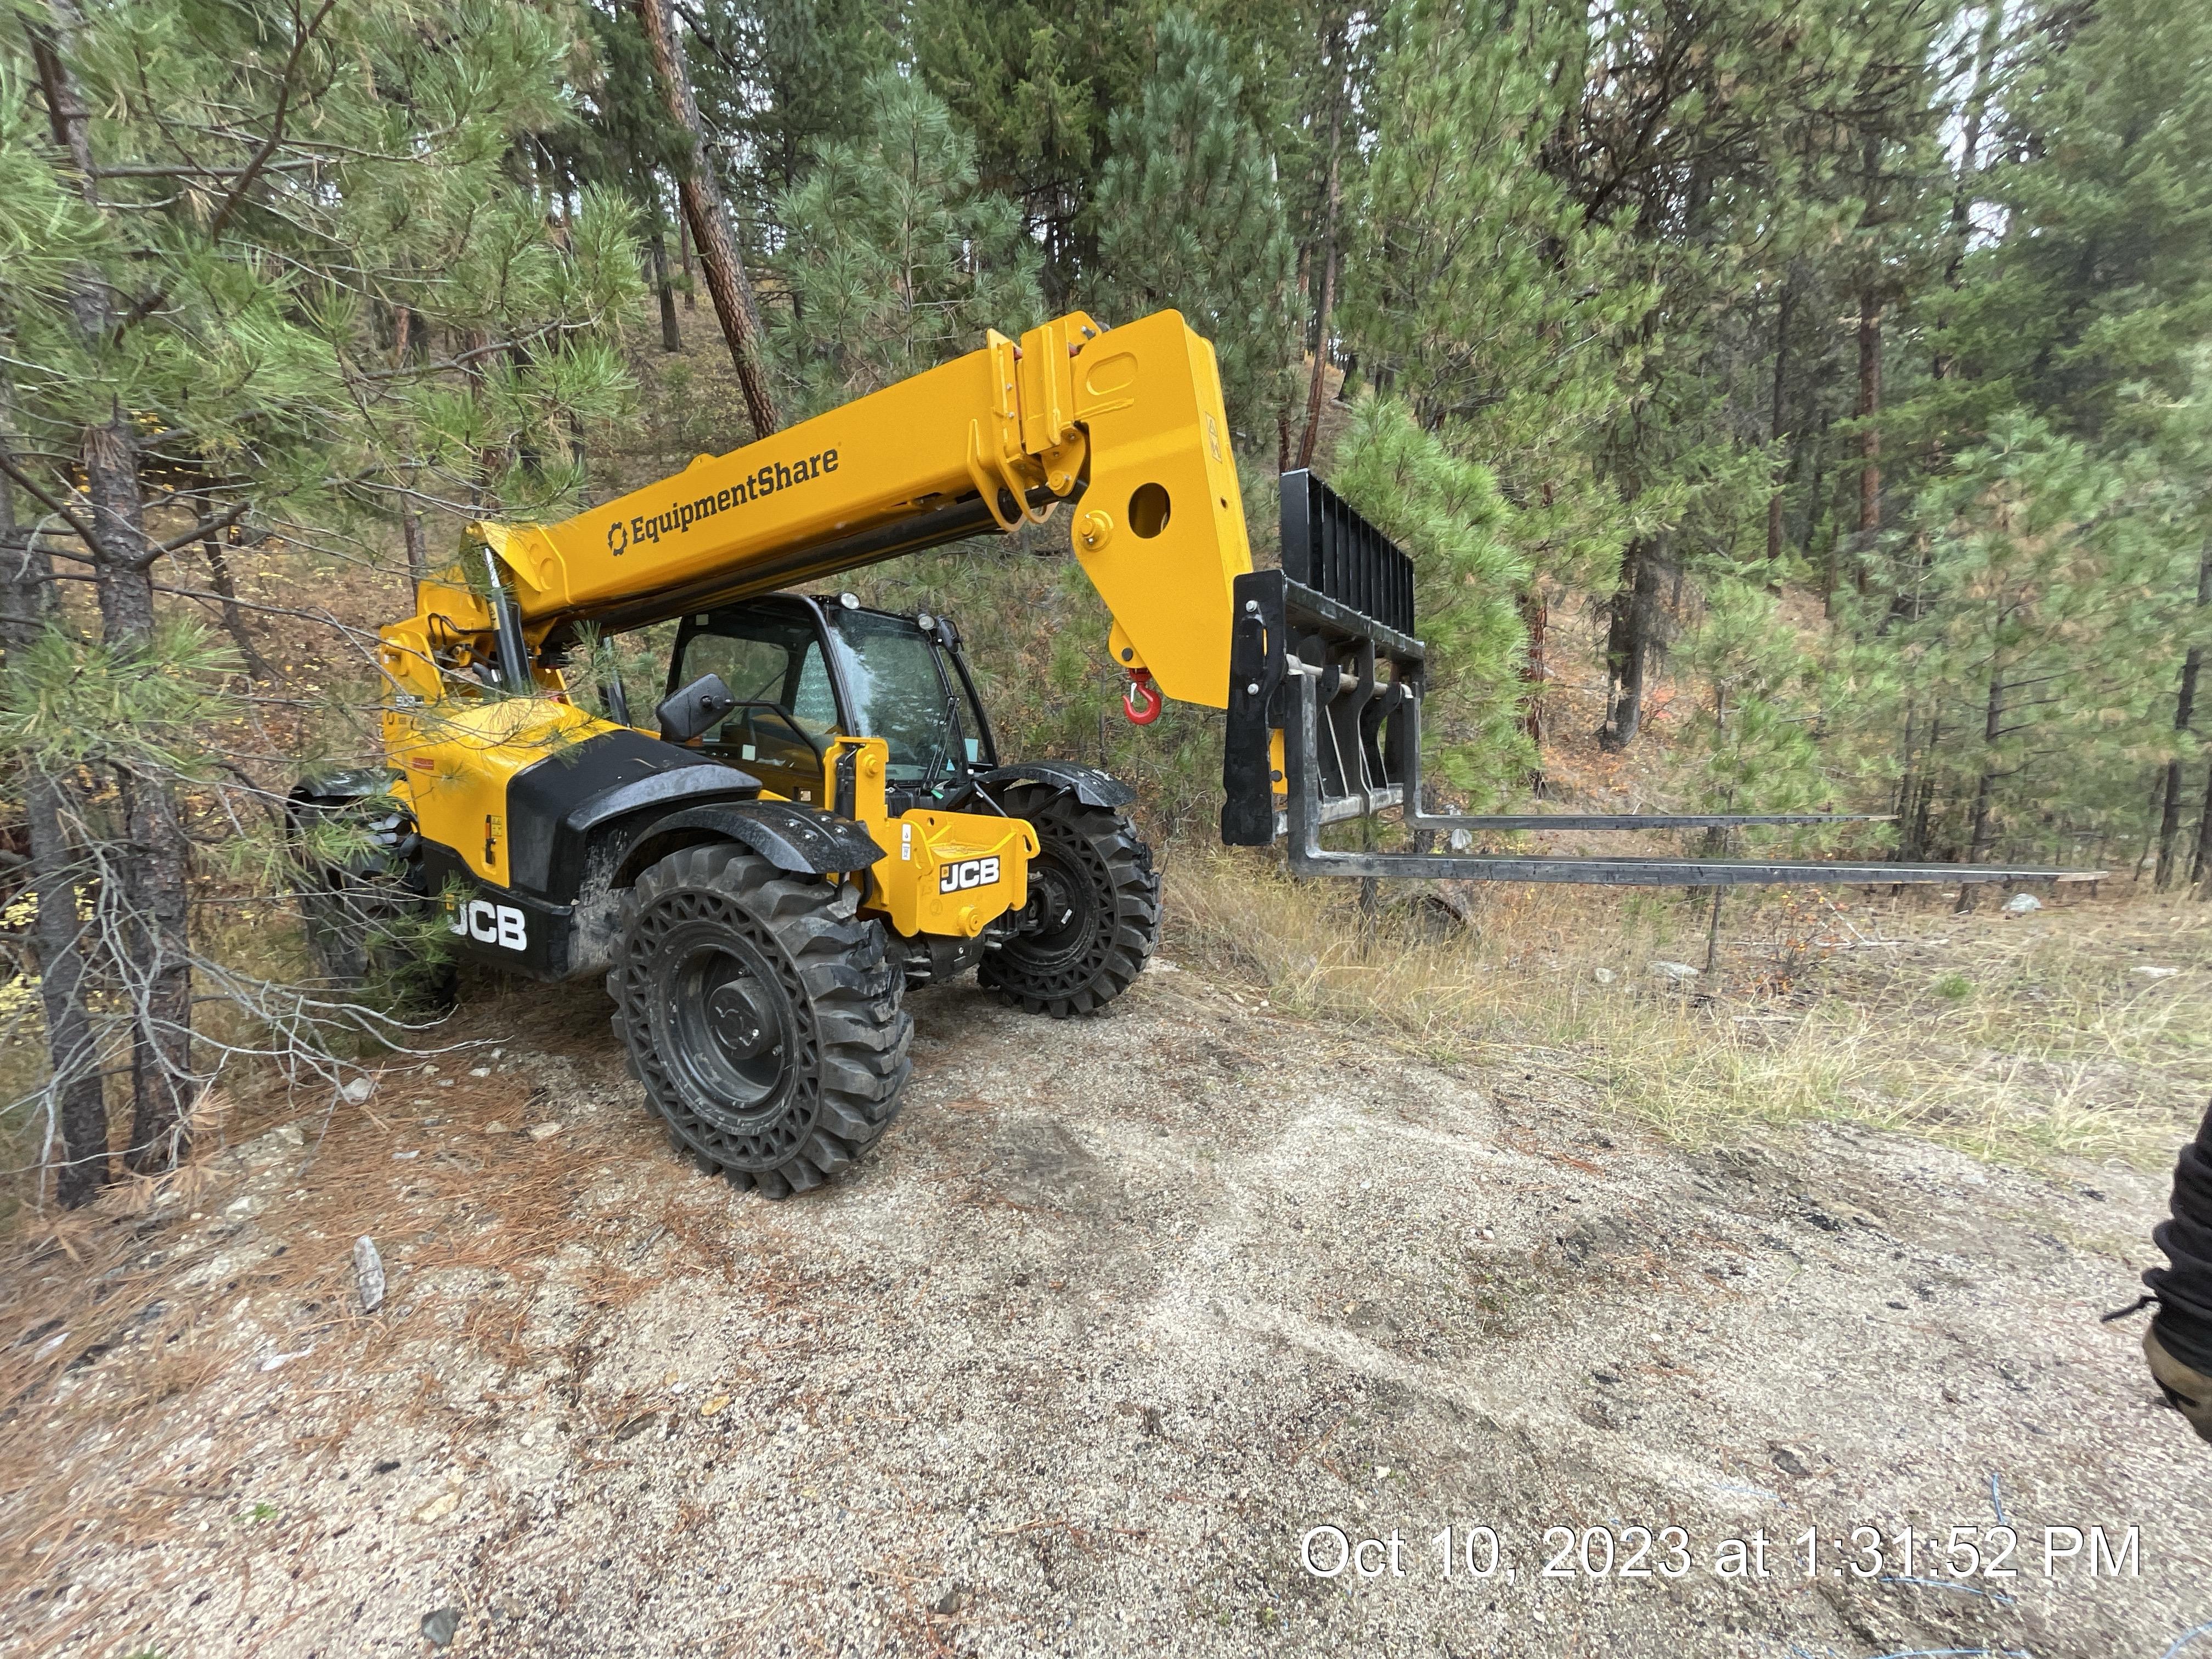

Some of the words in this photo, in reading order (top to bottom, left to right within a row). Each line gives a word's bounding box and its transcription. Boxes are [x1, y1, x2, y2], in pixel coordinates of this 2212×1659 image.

[631, 448, 839, 545] EquipmentShare
[940, 857, 999, 892] JCB
[447, 897, 528, 951] JCB
